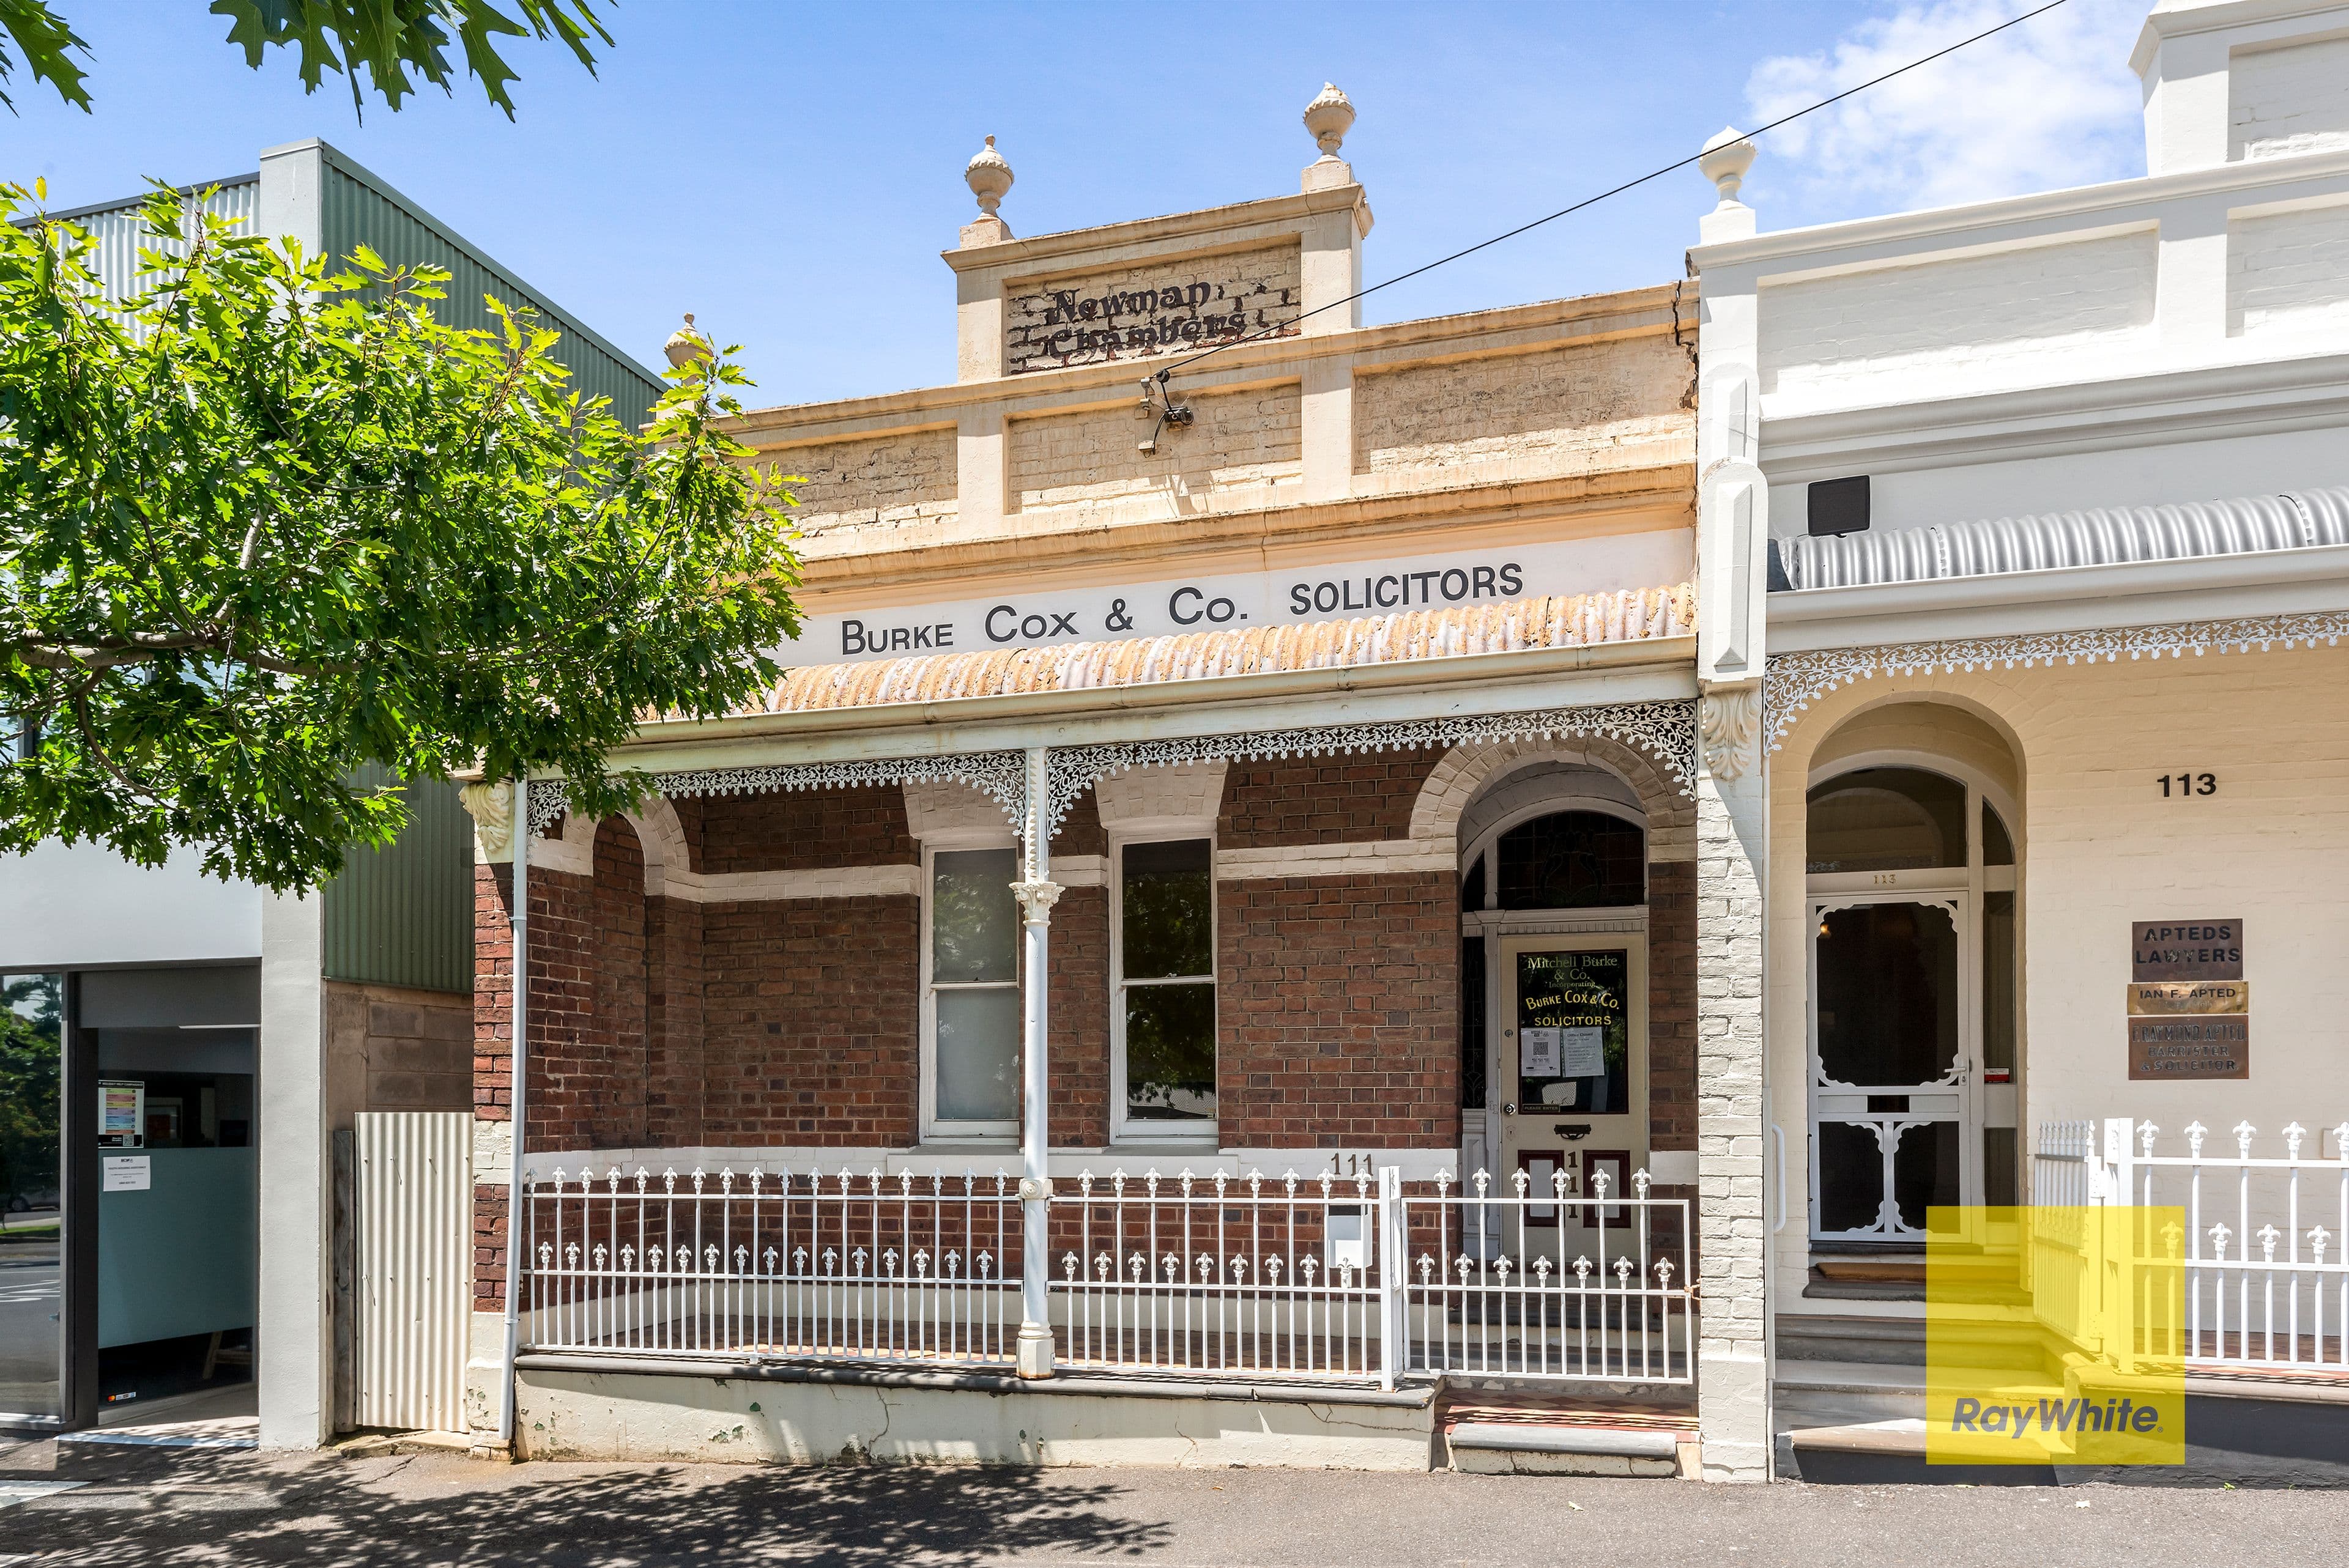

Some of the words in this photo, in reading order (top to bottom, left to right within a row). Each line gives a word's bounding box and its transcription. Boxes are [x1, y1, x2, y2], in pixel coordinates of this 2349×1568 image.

[1045, 281, 1211, 325] Newman
[1049, 312, 1246, 361] Chambers
[1105, 597, 1134, 632] &
[1290, 563, 1523, 615] SOLICITORS
[2157, 773, 2217, 797] 113
[1874, 874, 1896, 885] 113
[2144, 926, 2232, 942] APTEDS
[1527, 956, 1576, 969] Mitchell
[1582, 955, 1617, 967] Burke
[2136, 948, 2241, 964] LAWYERS
[1554, 969, 1564, 980] &
[1590, 995, 1598, 1004] &
[2140, 989, 2164, 999] IAN
[2170, 989, 2181, 999] F.
[2189, 988, 2236, 998] APTED
[1535, 1015, 1611, 1026] SOLICITORS
[2148, 1046, 2229, 1057] BARRISTER
[2141, 1061, 2150, 1071] &
[1331, 1153, 1373, 1176] 111
